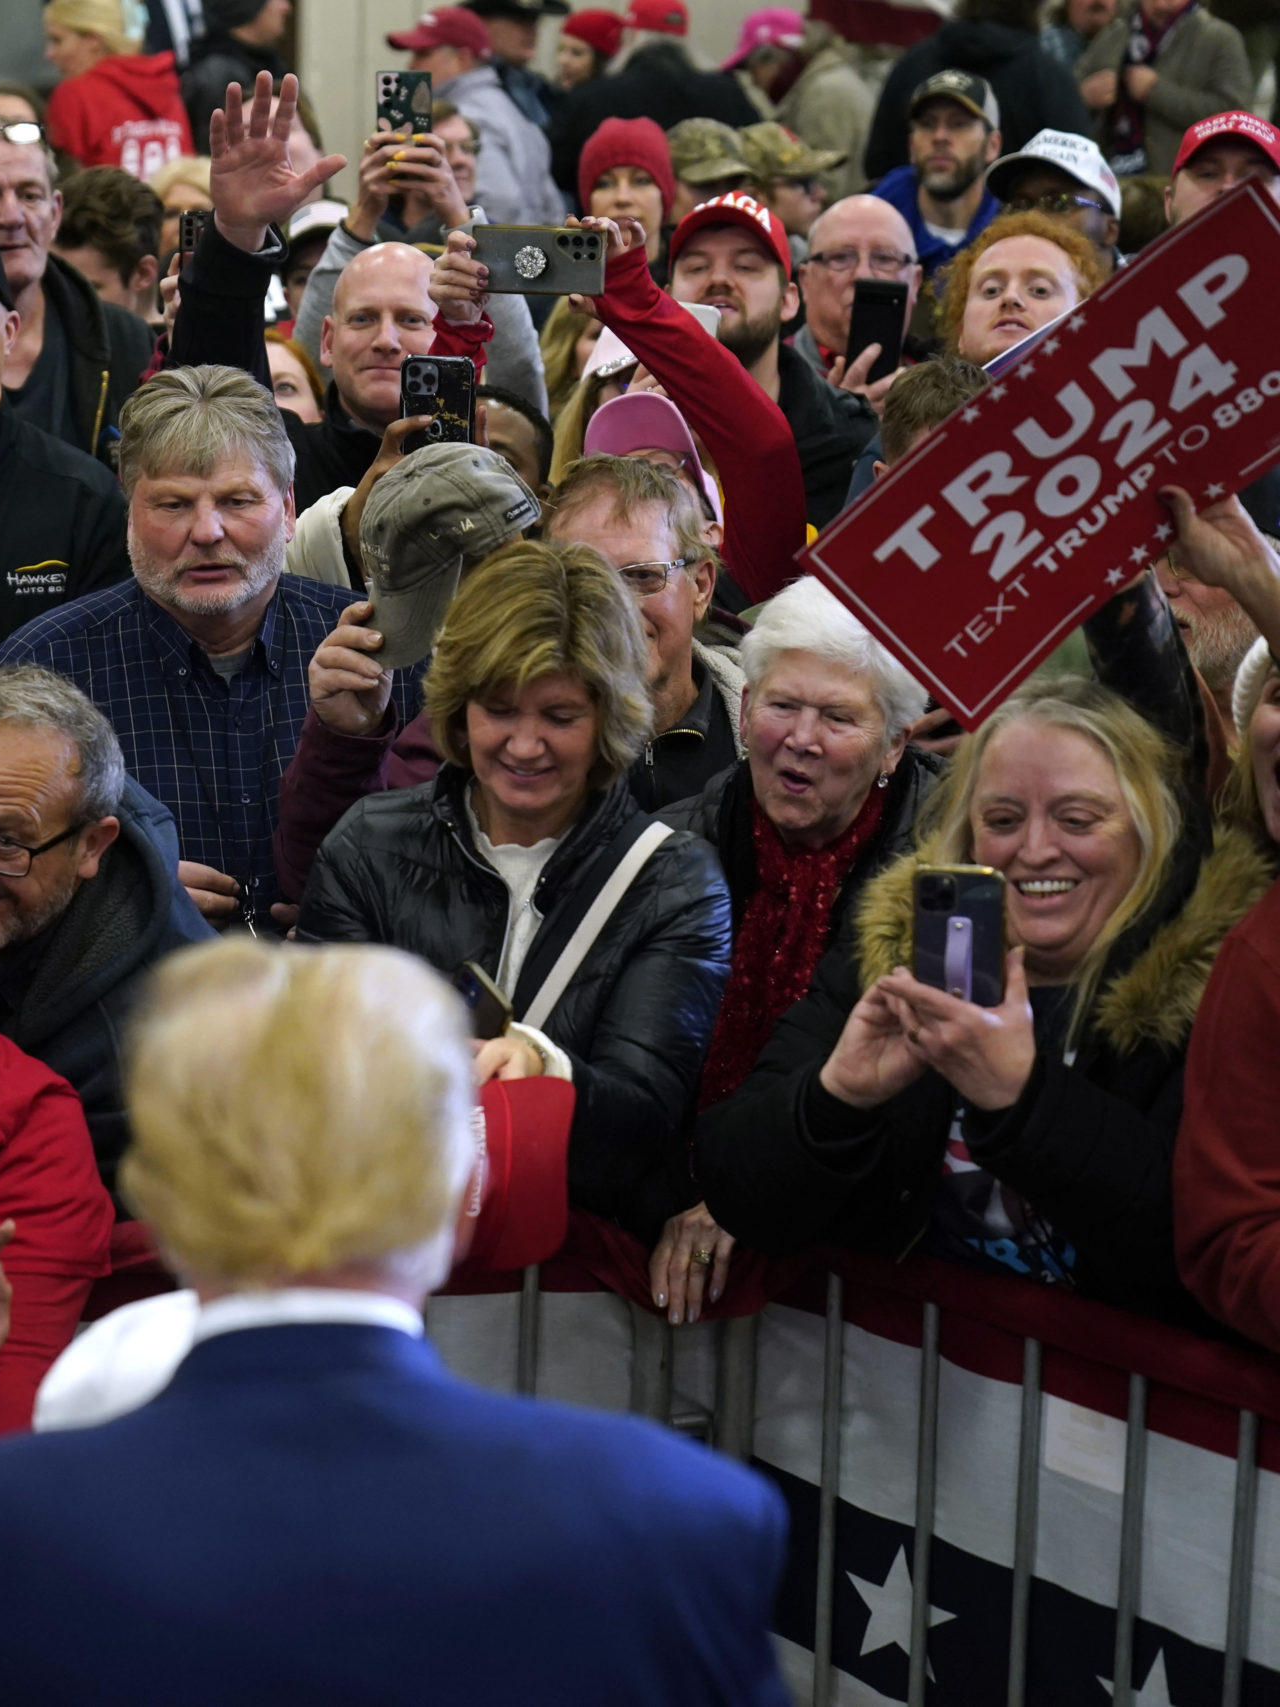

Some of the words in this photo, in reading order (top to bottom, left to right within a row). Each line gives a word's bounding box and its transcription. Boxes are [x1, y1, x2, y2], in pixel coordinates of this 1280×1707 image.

[1194, 116, 1226, 133] MAKE
[872, 254, 1249, 572] TRUMP
[970, 343, 1239, 582] 2024
[15, 586, 45, 594] AUTO
[48, 585, 65, 593] BO
[943, 574, 1031, 658] TEXT
[1032, 462, 1155, 573] TRUMP
[1155, 425, 1210, 464] TO
